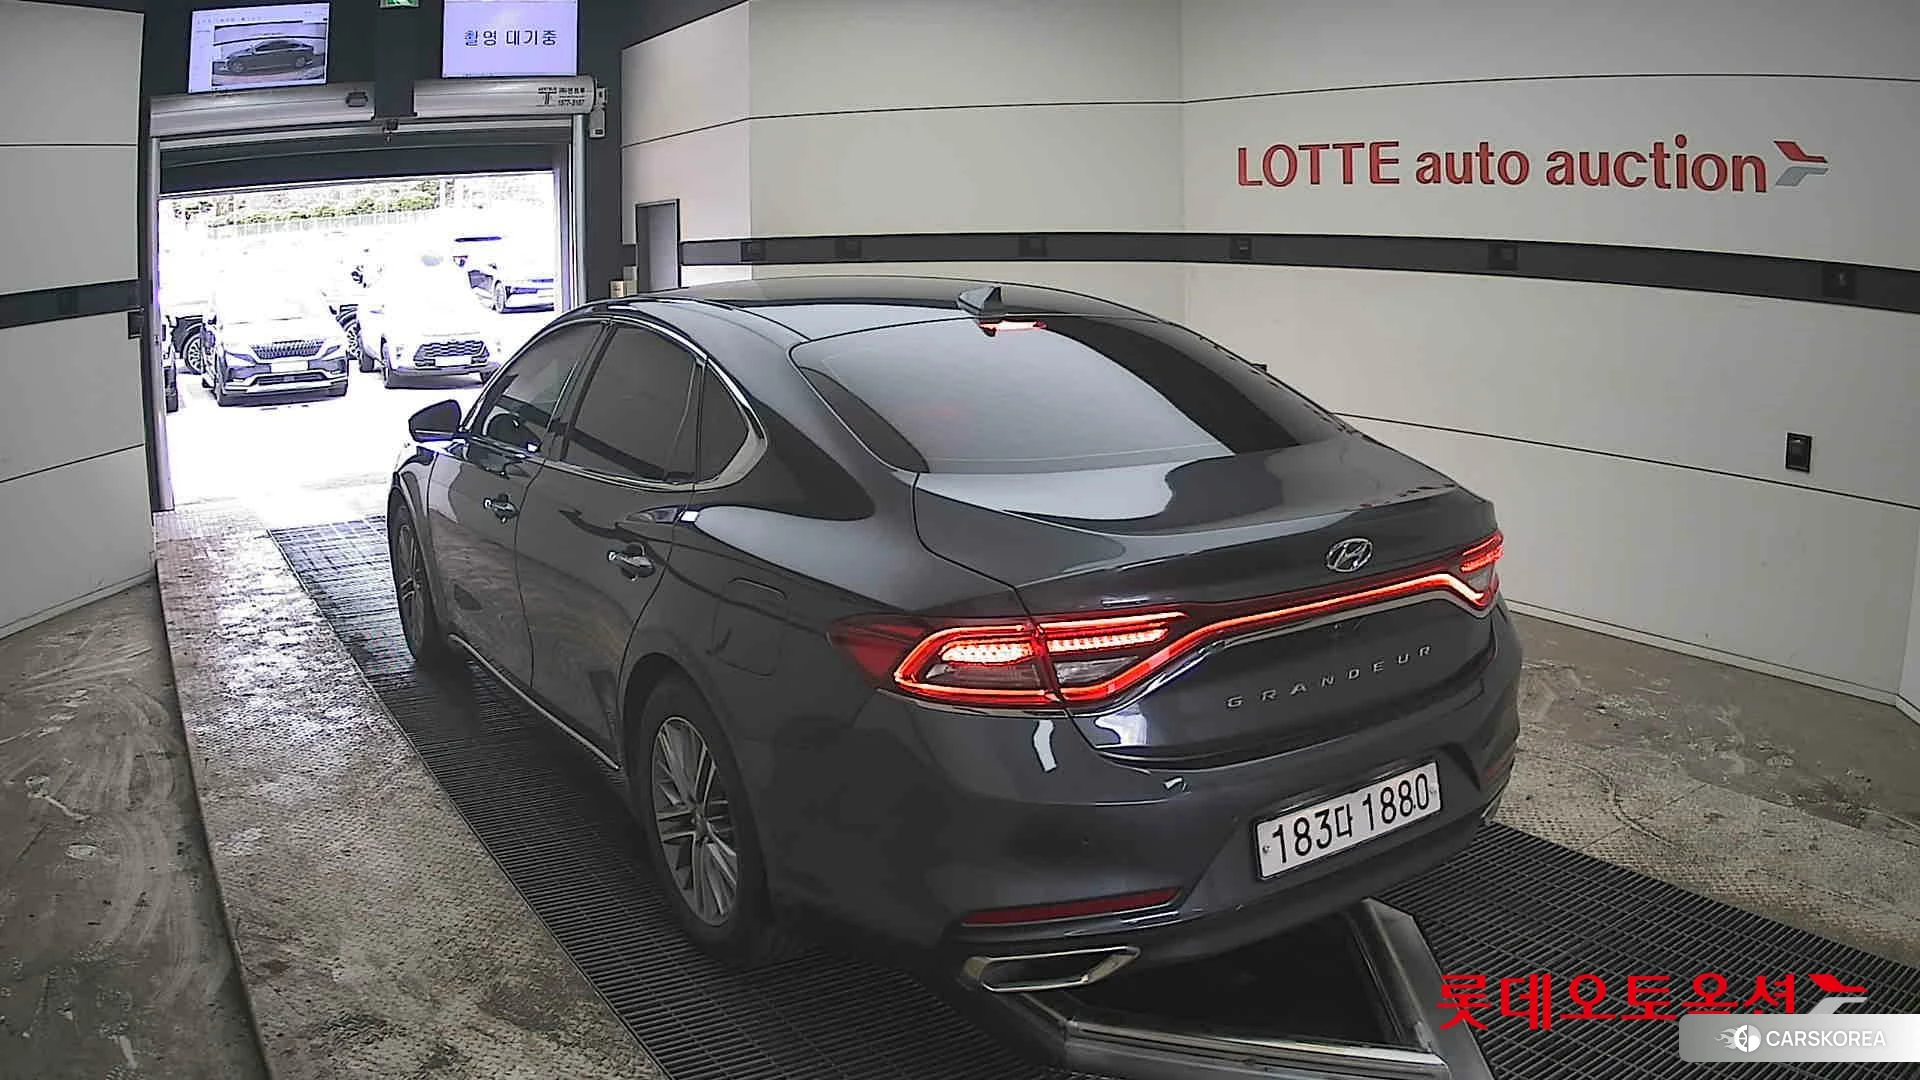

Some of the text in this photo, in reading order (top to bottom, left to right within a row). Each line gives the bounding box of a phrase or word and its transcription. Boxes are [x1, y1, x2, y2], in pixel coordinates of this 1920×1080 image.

[505, 30, 558, 47] 대기중
[1237, 135, 1767, 193] LOTTE auto auction
[1226, 644, 1432, 709] GRANDEUR
[1272, 773, 1430, 864] 183다 1880
